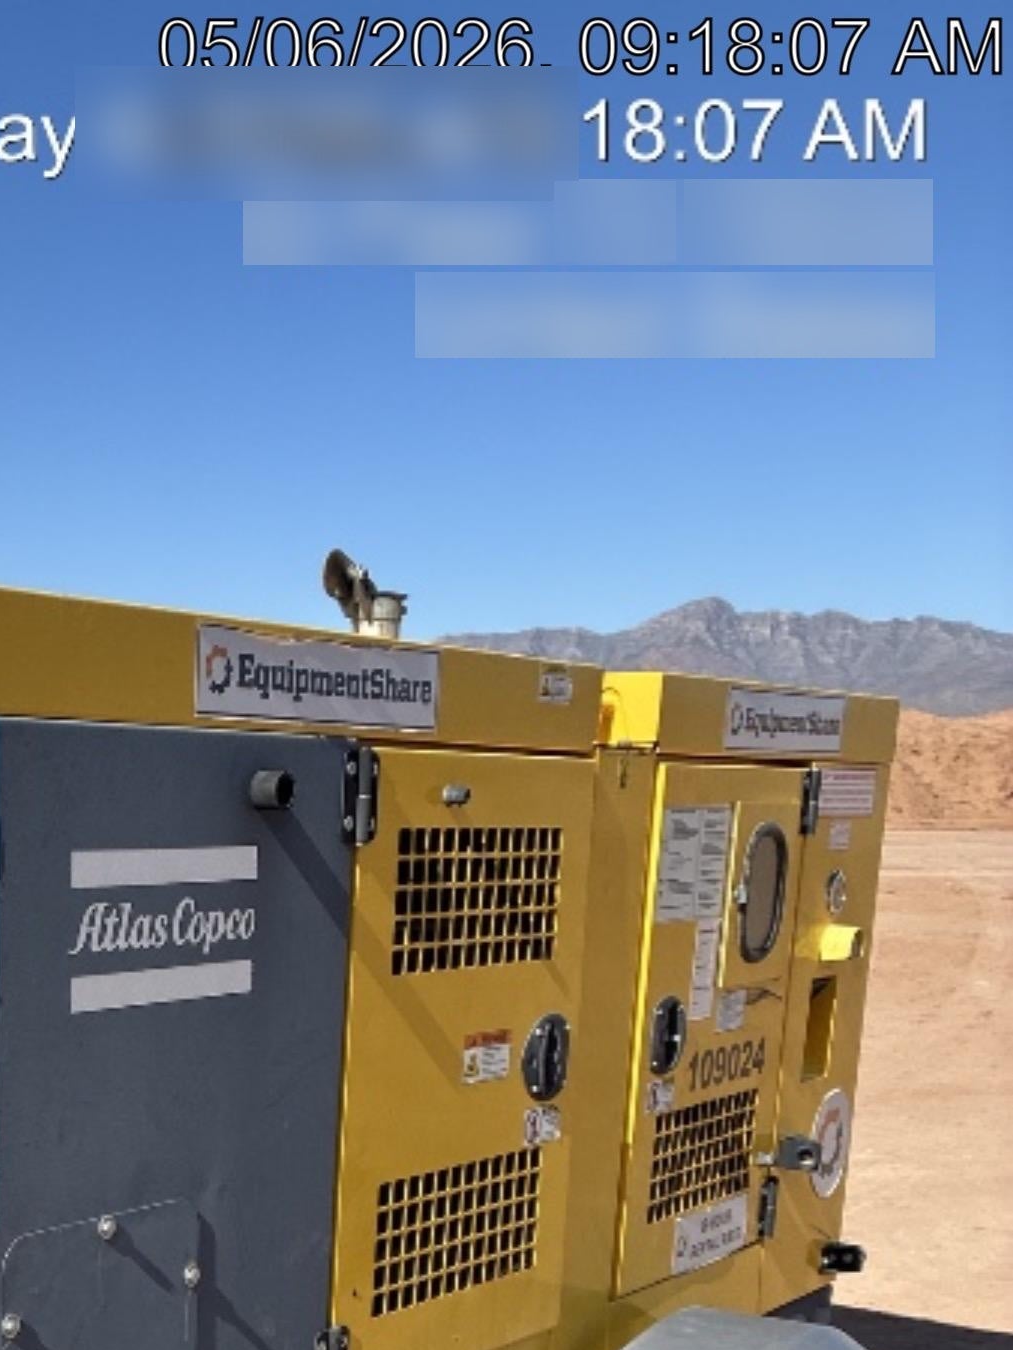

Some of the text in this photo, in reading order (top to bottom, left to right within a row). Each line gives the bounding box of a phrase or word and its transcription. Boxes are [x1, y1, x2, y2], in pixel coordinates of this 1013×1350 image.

[238, 653, 432, 703] EquipmentShare
[68, 896, 255, 955] Atlas Copco
[689, 1036, 765, 1093] 109024
